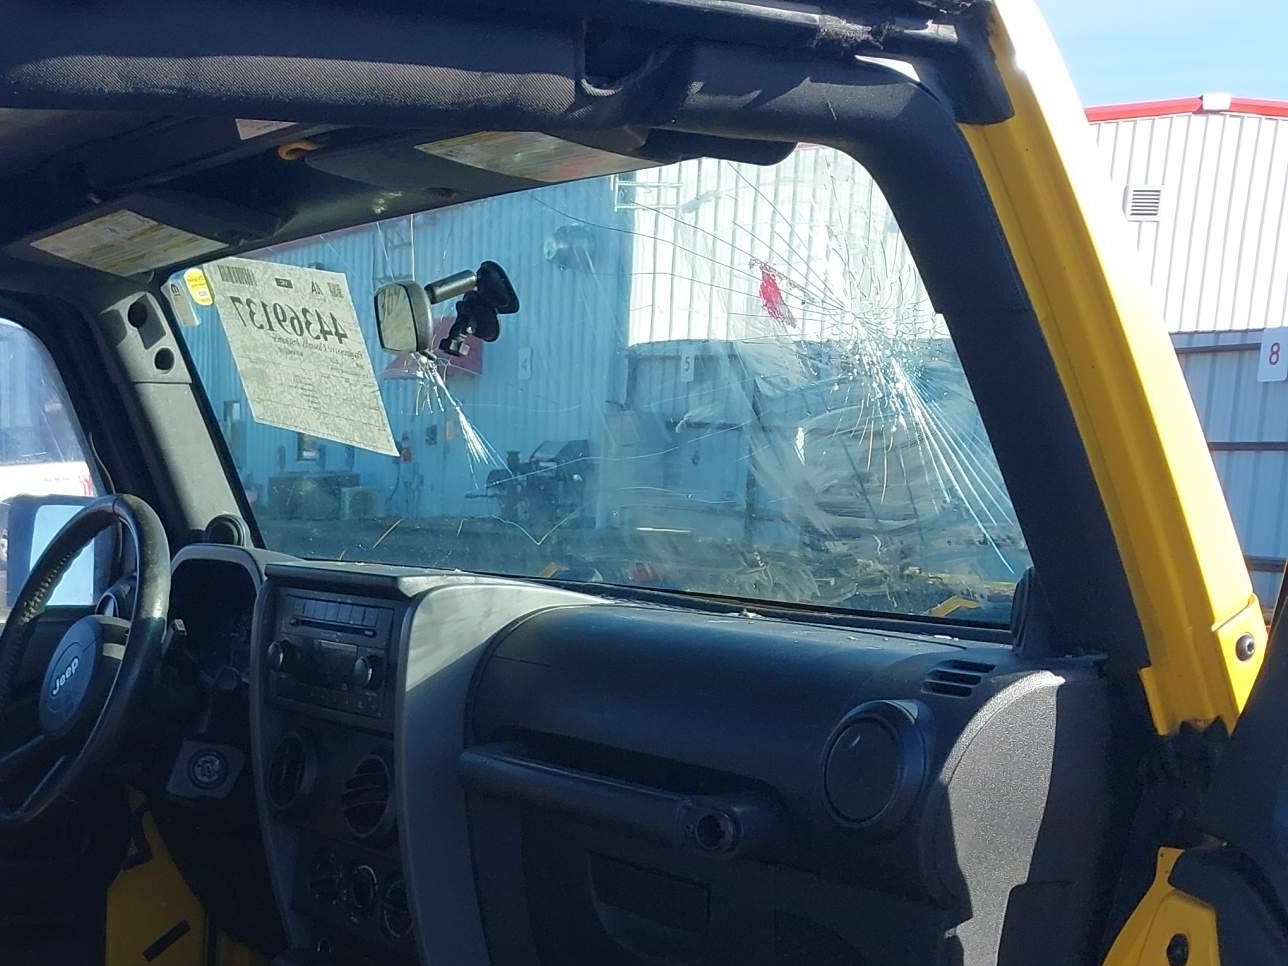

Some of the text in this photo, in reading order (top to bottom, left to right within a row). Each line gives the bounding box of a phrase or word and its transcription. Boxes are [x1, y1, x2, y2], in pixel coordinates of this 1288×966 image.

[684, 355, 691, 372] 5
[1268, 342, 1281, 366] 8
[52, 657, 79, 696] Jeep
